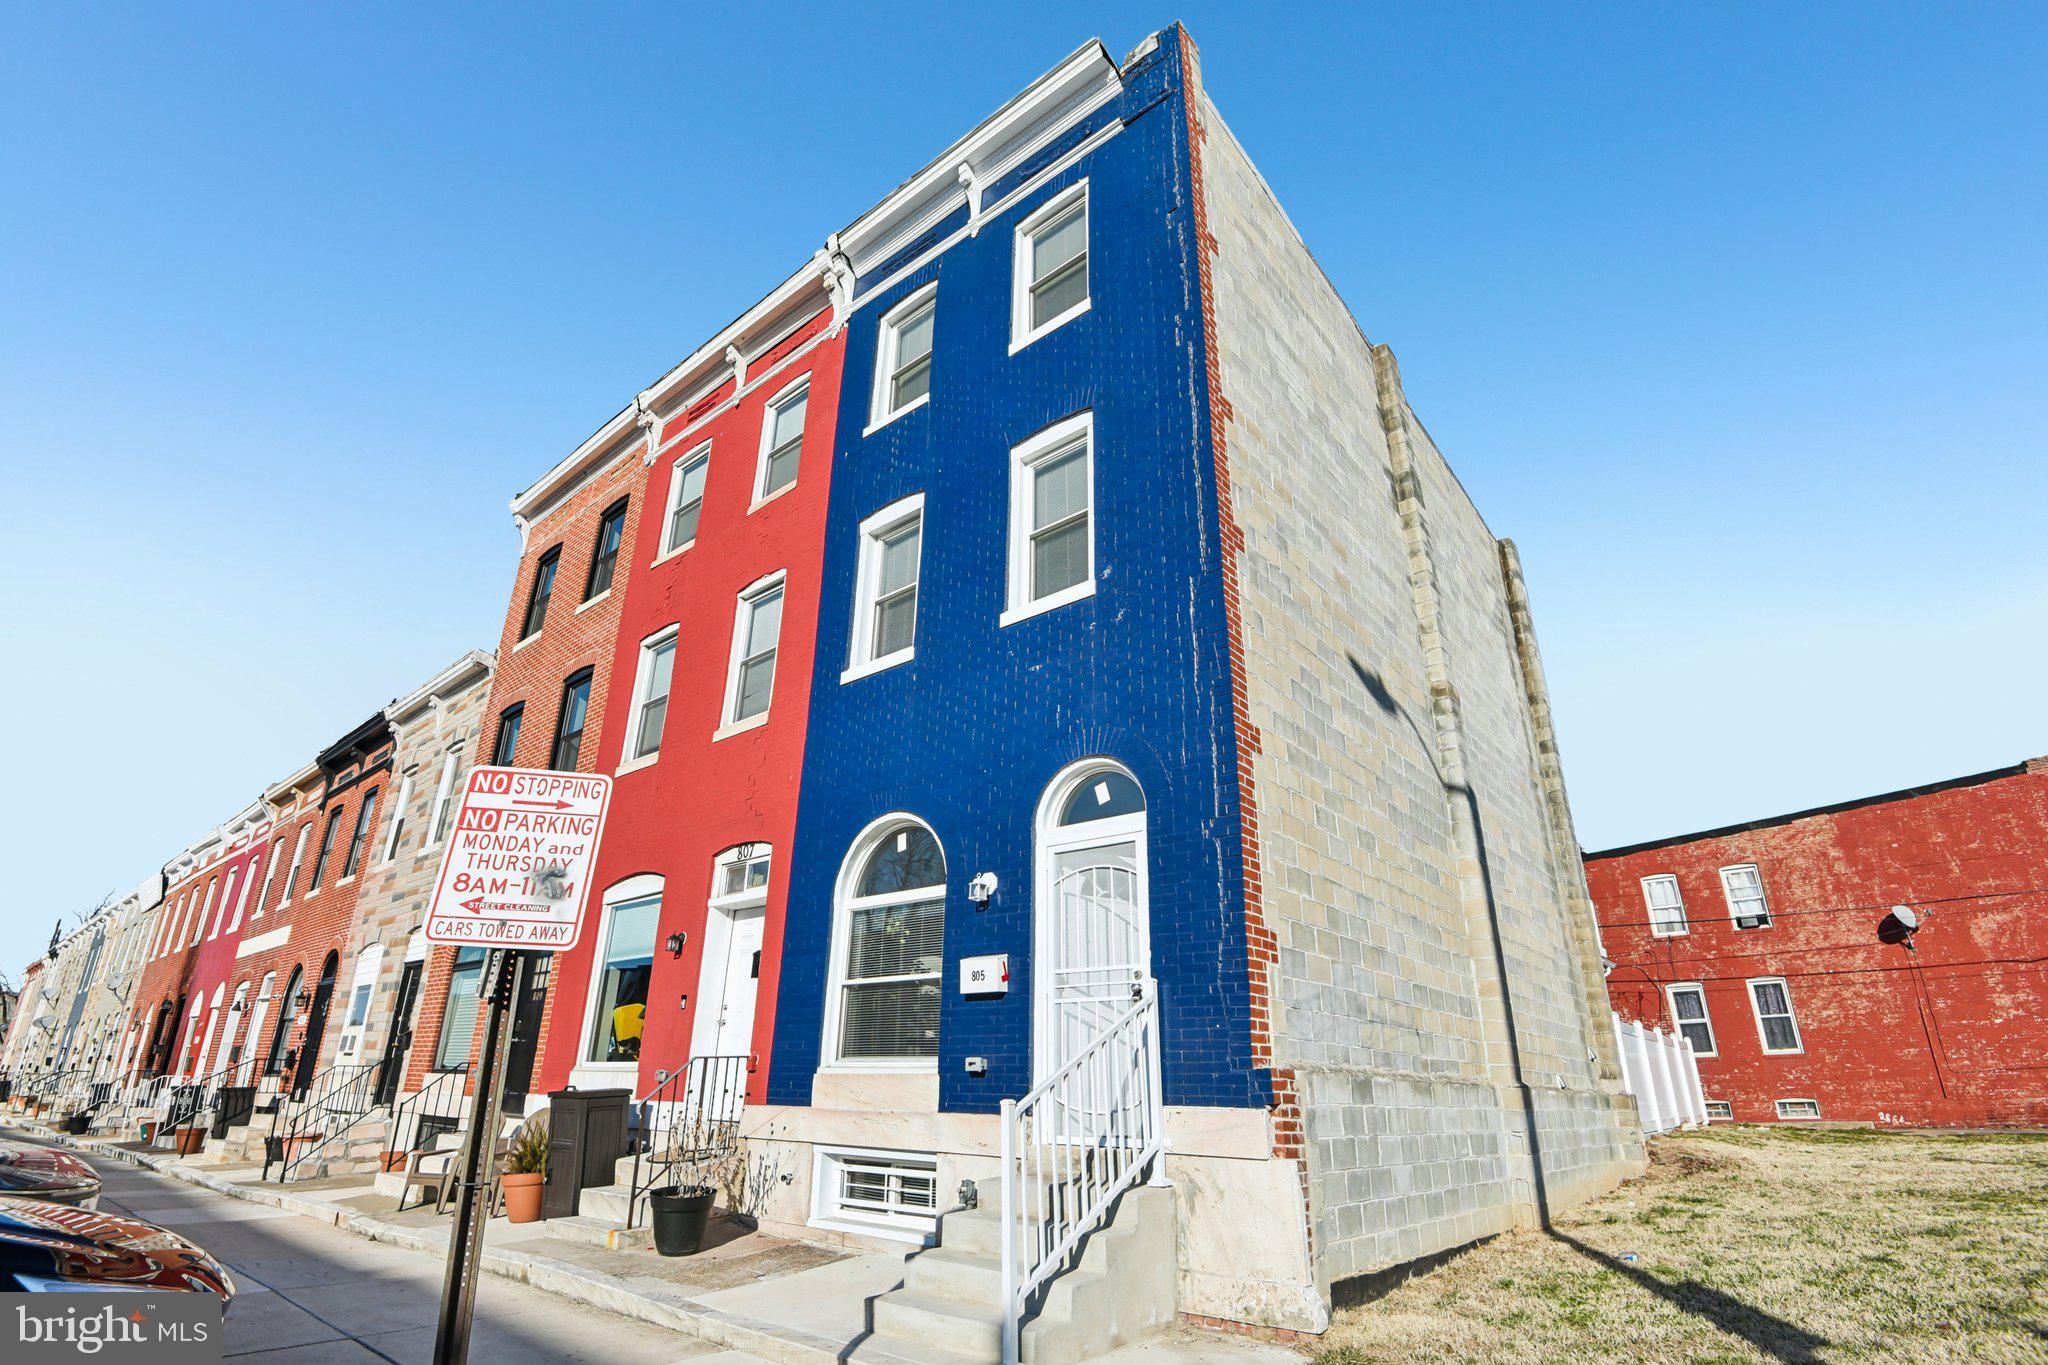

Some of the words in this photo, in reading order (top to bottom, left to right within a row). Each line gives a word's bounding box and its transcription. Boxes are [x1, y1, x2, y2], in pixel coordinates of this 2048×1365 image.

[474, 773, 507, 792] NO
[514, 776, 602, 799] STOPPING
[463, 810, 497, 829] NO
[504, 813, 594, 836] PARKING
[462, 834, 545, 852] MONDAY
[548, 844, 585, 856] and
[737, 844, 755, 860] 807
[467, 853, 573, 872] THURSDAY
[468, 901, 501, 910] STREET
[504, 904, 551, 913] CLEANING
[435, 921, 473, 936] CARS
[479, 923, 524, 939] TOWED
[528, 925, 568, 941] AWAY
[971, 970, 985, 981] 805
